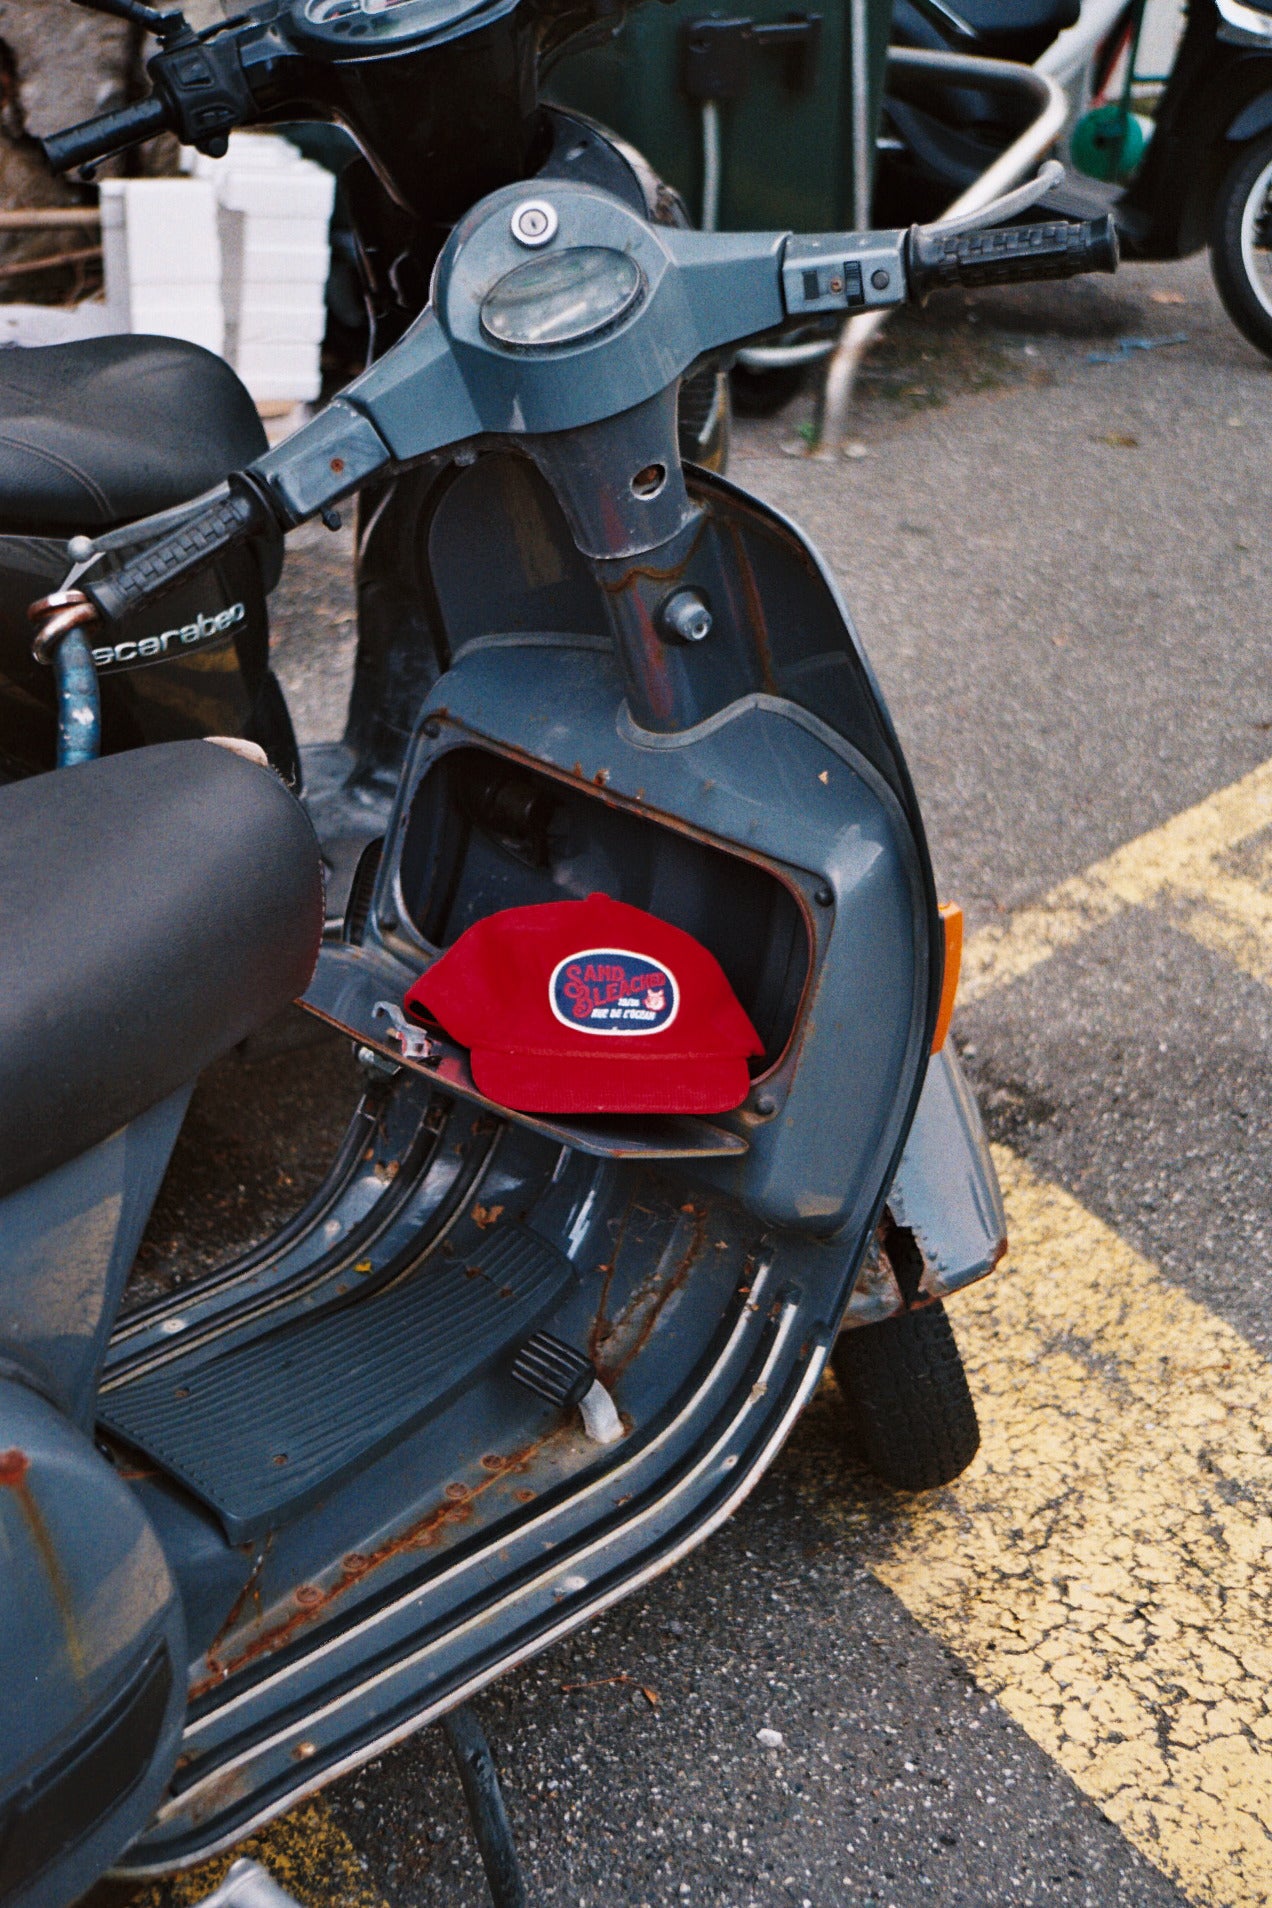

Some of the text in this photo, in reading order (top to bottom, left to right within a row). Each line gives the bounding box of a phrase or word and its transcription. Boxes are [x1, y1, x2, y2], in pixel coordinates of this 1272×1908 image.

[91, 602, 245, 666] scarabeo
[564, 972, 667, 1018] BLEACHED
[565, 964, 626, 987] SAND
